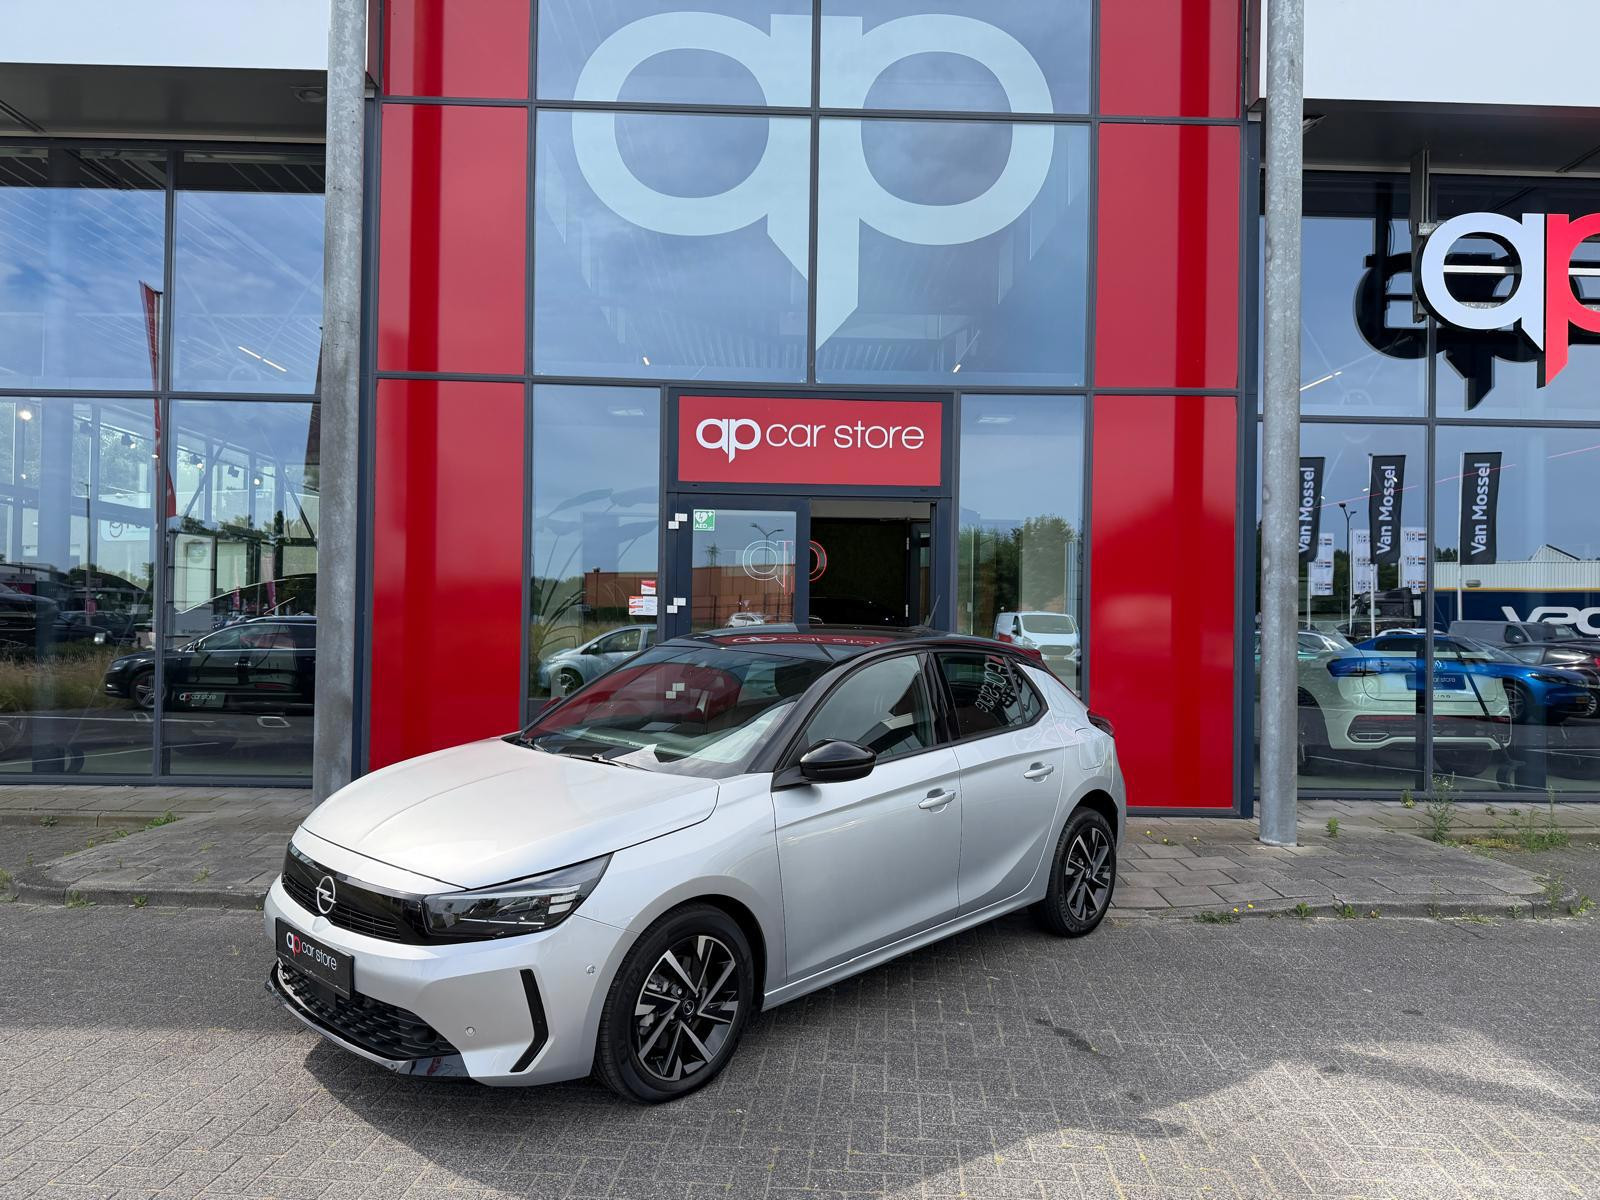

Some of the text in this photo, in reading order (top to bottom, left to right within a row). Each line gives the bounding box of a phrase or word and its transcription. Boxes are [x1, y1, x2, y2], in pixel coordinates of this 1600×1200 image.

[696, 418, 925, 464] ap car store
[1299, 467, 1315, 521] Mossel
[1376, 465, 1396, 555] Van Mossel
[1471, 462, 1491, 556] Van Mossel
[286, 931, 337, 971] ap car store
